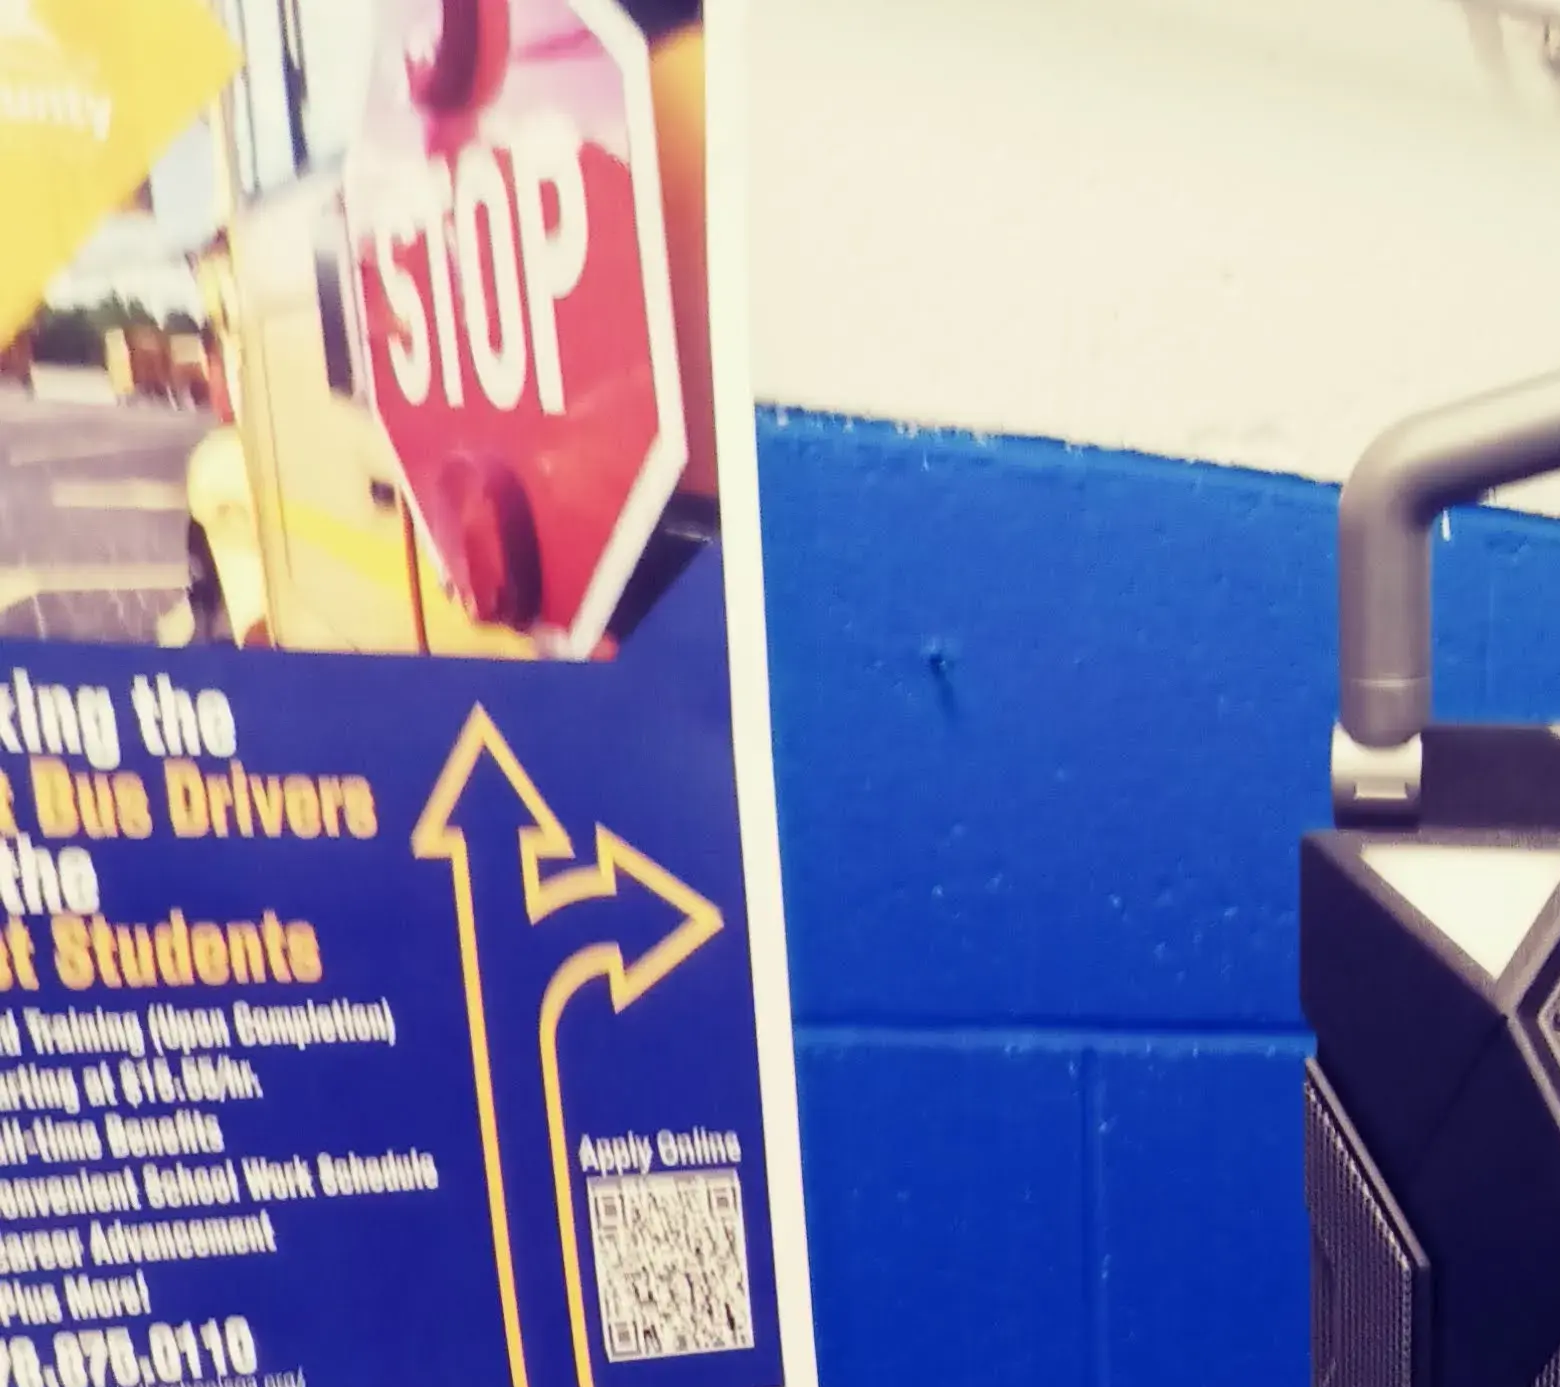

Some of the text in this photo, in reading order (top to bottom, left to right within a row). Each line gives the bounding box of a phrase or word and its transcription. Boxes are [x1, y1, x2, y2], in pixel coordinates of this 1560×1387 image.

[372, 137, 589, 415] STOP
[131, 672, 236, 758] the
[30, 756, 152, 839] Bus
[164, 758, 378, 839] Drivers
[51, 907, 322, 990] Students
[23, 1005, 145, 1057] Training
[148, 1003, 231, 1055] (Upon
[233, 996, 396, 1050] Completion)
[84, 1060, 118, 1107] at
[105, 1109, 224, 1159] Benefits
[578, 1126, 741, 1177] Apply Online
[143, 1158, 240, 1209] School
[242, 1154, 316, 1202] Work
[317, 1147, 438, 1196] Schedule
[90, 1208, 277, 1266] Advancement
